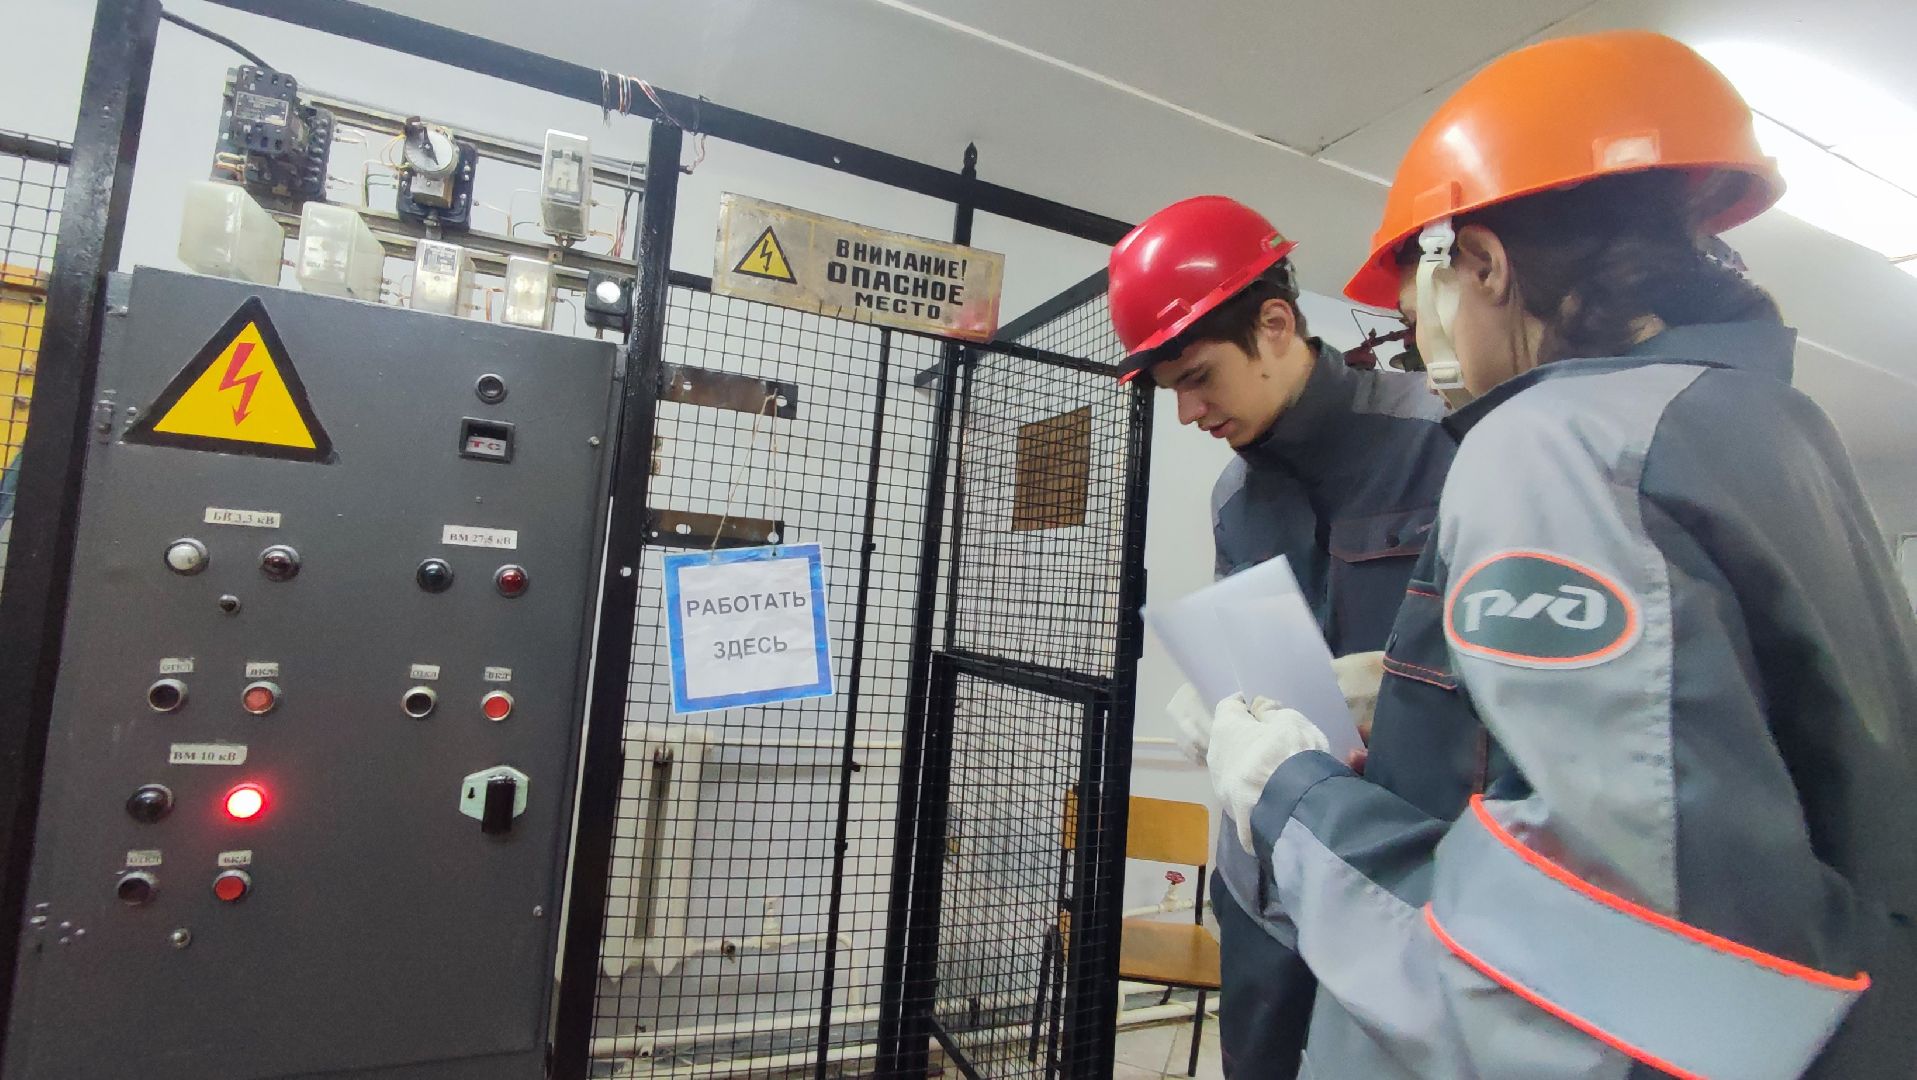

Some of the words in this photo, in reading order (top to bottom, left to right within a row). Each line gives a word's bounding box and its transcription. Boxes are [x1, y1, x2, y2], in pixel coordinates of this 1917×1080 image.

[836, 239, 968, 281] ВНИМАНИЕ!
[827, 261, 965, 306] ОПАСНОЕ
[855, 291, 941, 320] МЕСТО
[449, 533, 469, 542] ВМ
[686, 591, 806, 617] РАБОТАТЬ
[713, 635, 788, 661] ЗДЕСЬ
[173, 751, 197, 761] ВМ
[201, 751, 215, 761] 10
[218, 751, 237, 761] кВ
